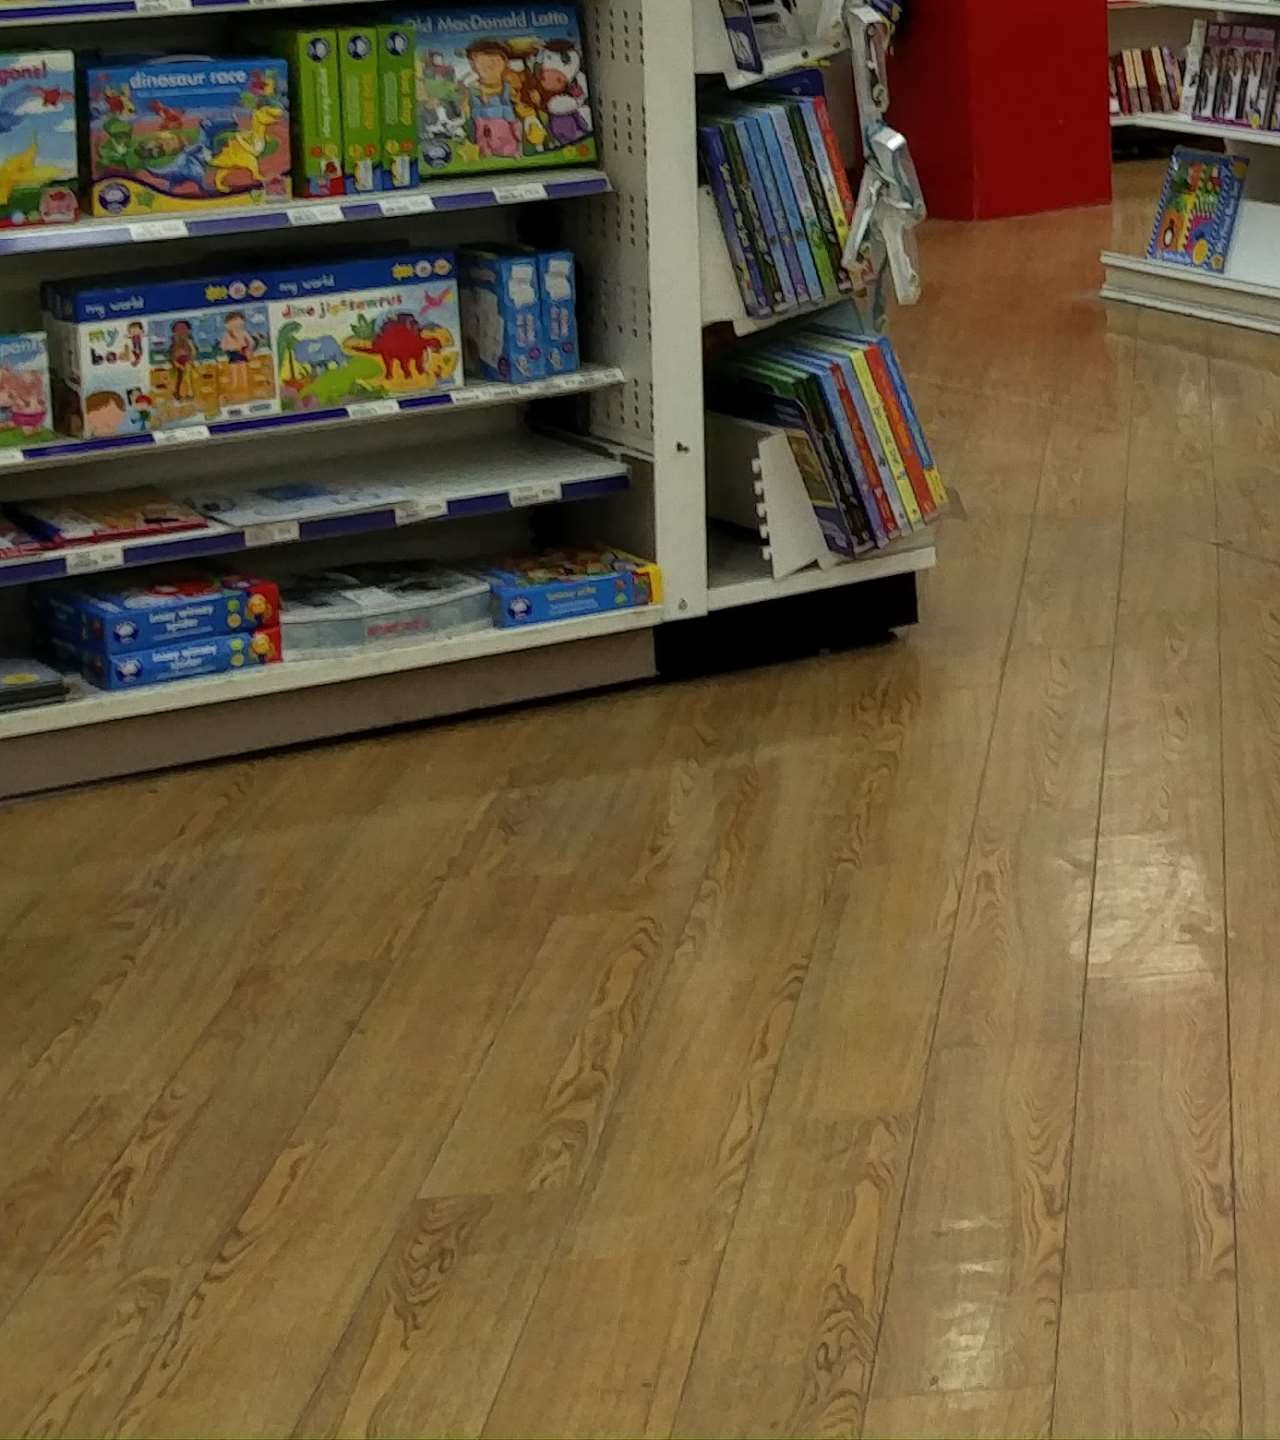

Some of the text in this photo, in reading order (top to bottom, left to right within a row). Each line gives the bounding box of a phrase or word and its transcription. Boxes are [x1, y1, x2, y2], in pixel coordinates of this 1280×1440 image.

[437, 11, 528, 32] MacDonald
[531, 9, 570, 27] Lotto
[128, 68, 249, 90] dinosaur race
[280, 272, 336, 296] my world
[85, 296, 145, 317] my world
[281, 303, 316, 320] dino
[88, 327, 121, 348] my
[91, 346, 144, 368] body
